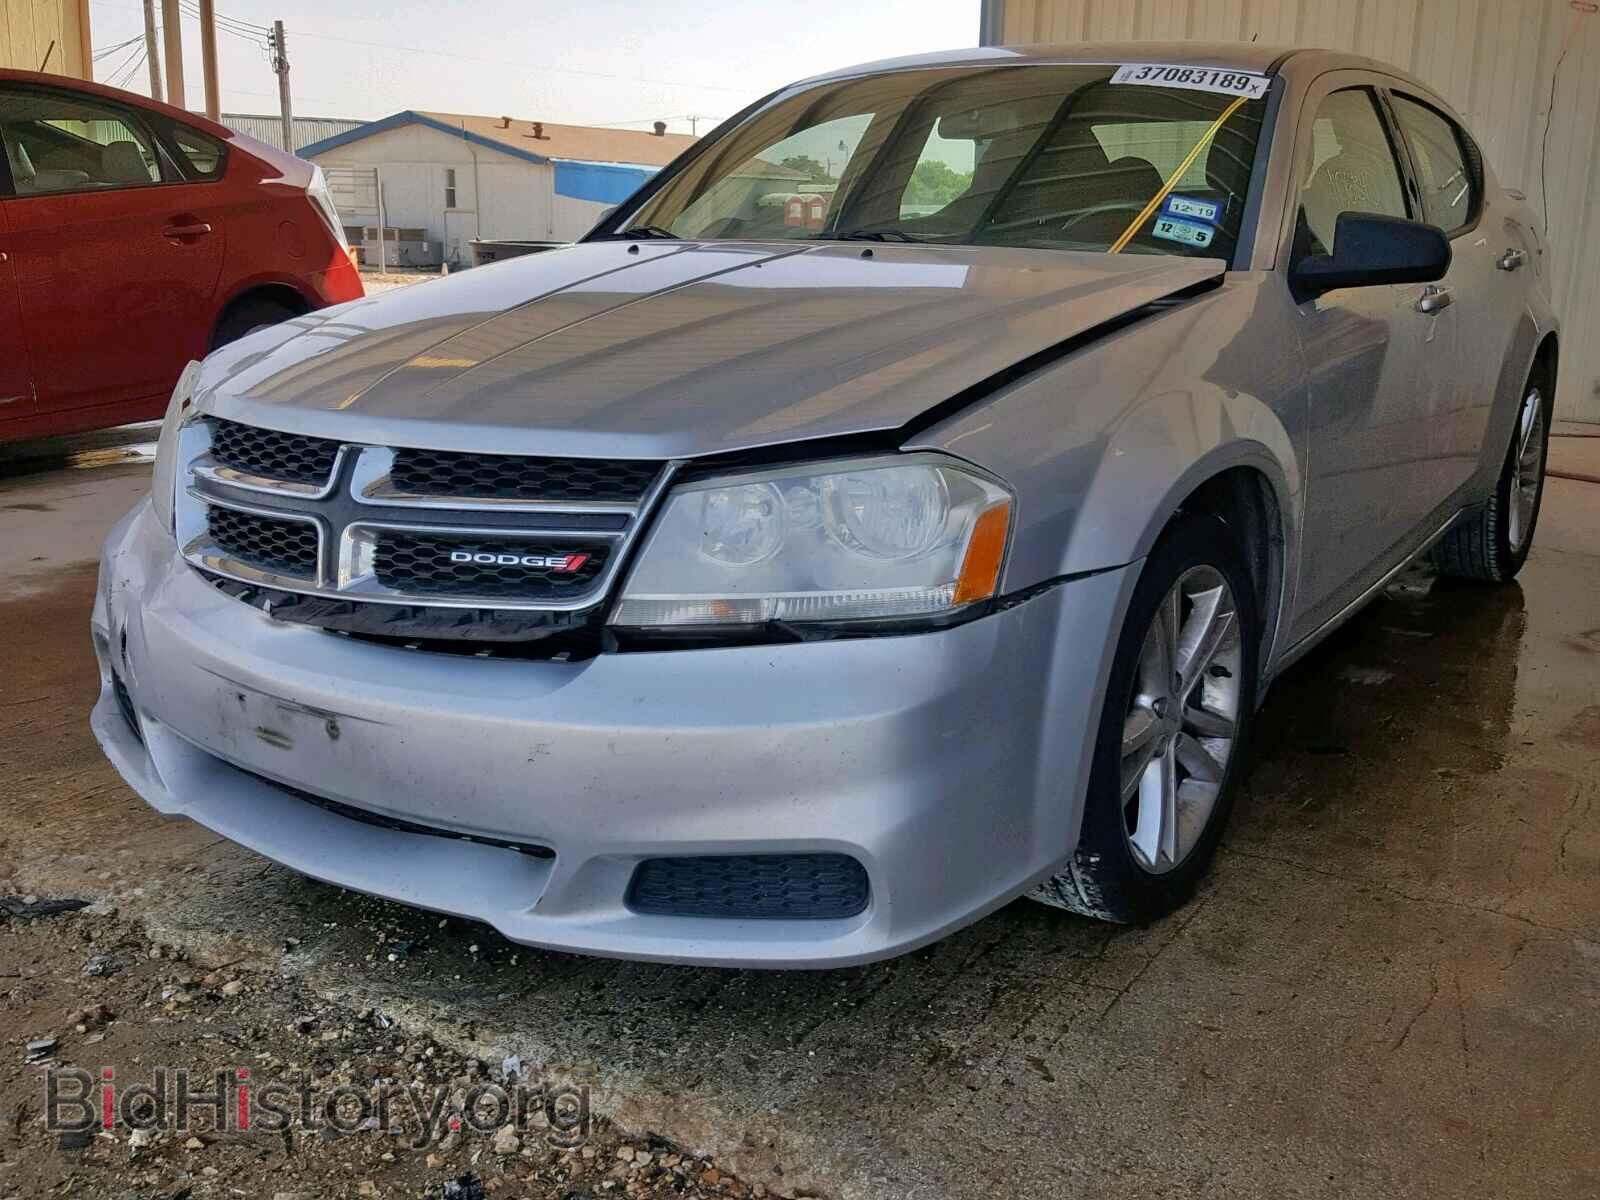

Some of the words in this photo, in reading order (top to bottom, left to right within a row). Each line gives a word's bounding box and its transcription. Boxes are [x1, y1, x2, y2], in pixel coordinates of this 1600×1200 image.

[1136, 67, 1251, 90] 37083189
[1160, 222, 1173, 233] 12
[450, 551, 568, 567] DODGE
